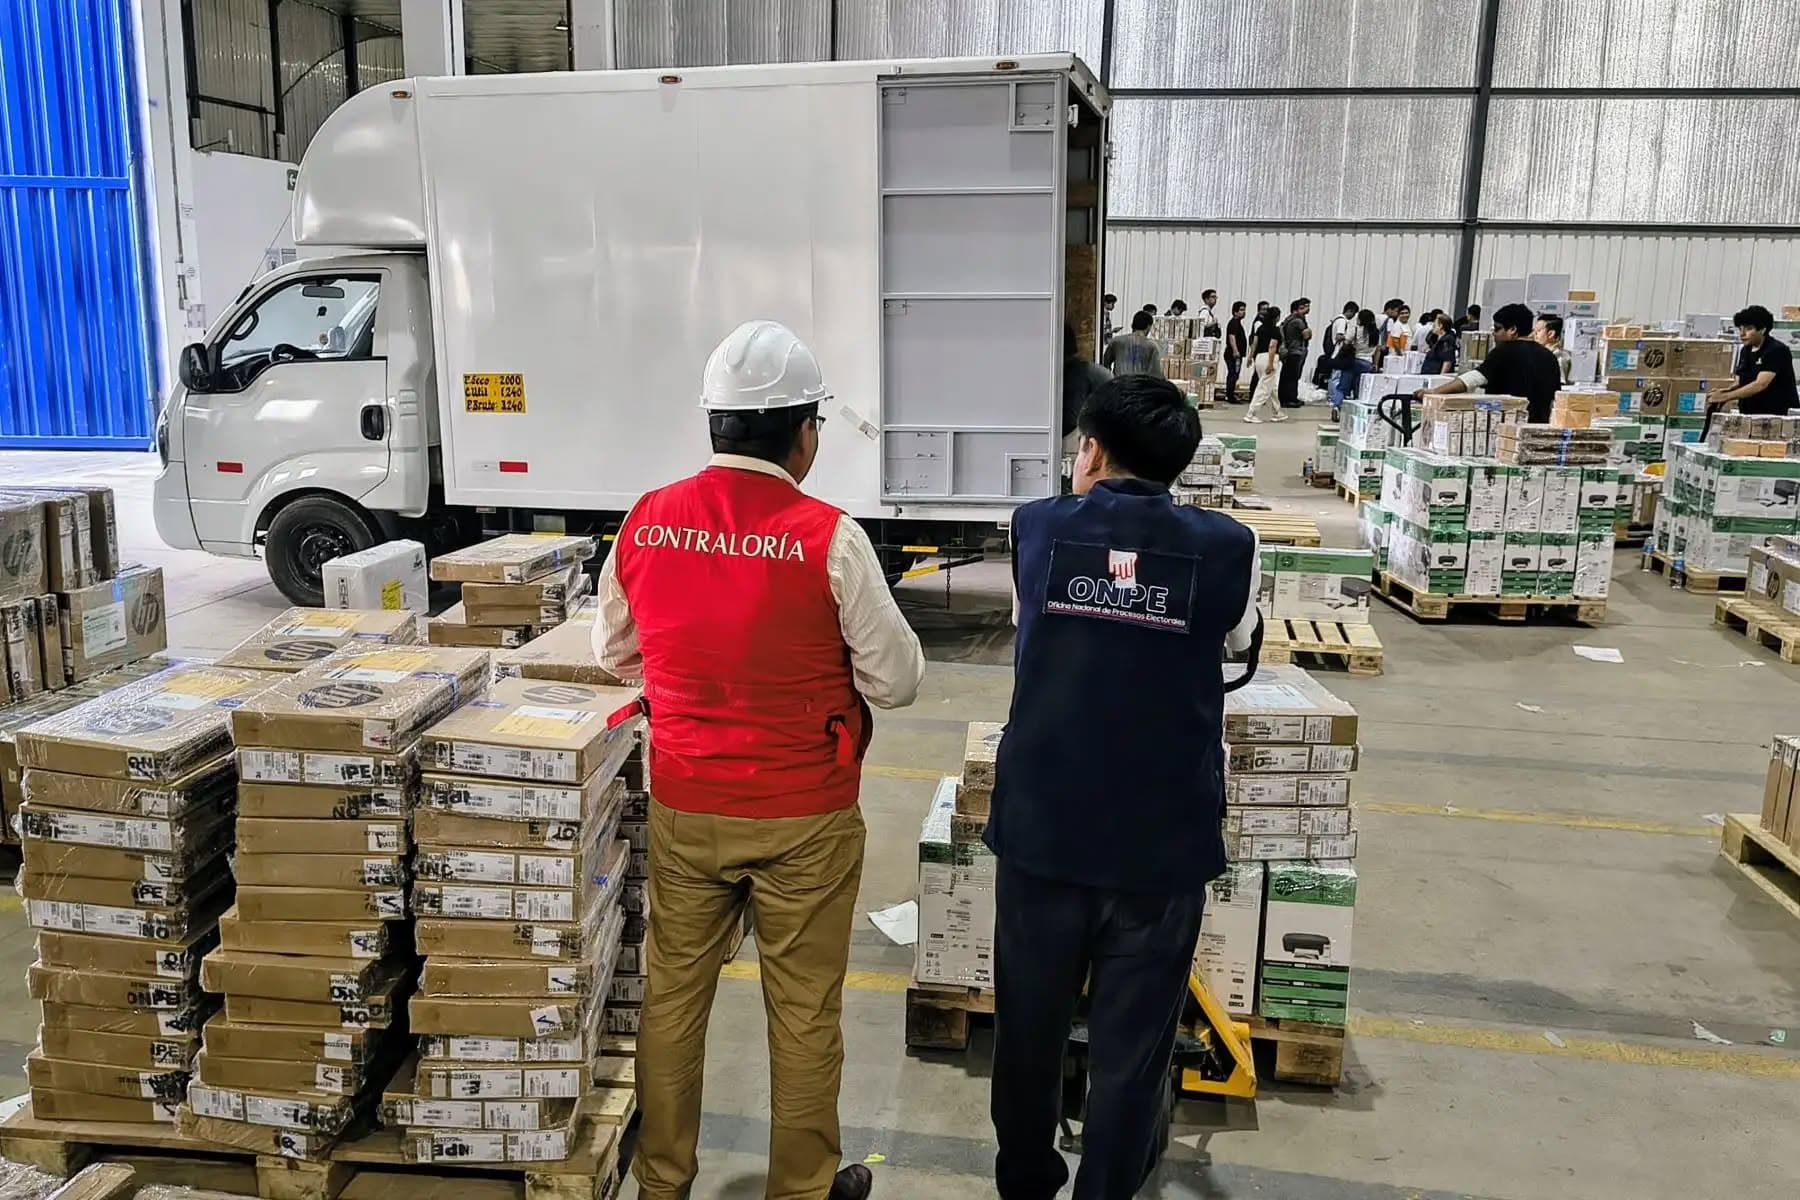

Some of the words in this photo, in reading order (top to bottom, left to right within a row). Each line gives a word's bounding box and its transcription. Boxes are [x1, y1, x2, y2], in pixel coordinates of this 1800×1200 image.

[1644, 348, 1664, 368] hp
[500, 376, 521, 385] 2000
[501, 387, 522, 398] 1240
[1643, 387, 1664, 406] hp
[501, 400, 522, 411] 3240
[634, 524, 805, 562] CONTRALORÍA
[1068, 576, 1168, 613] ONPE
[132, 592, 160, 636] hp
[1048, 601, 1072, 610] Oficina
[1072, 603, 1101, 613] Nacional
[1102, 606, 1112, 614] de
[1112, 608, 1145, 620] Procesos
[1146, 614, 1186, 626] Electorales
